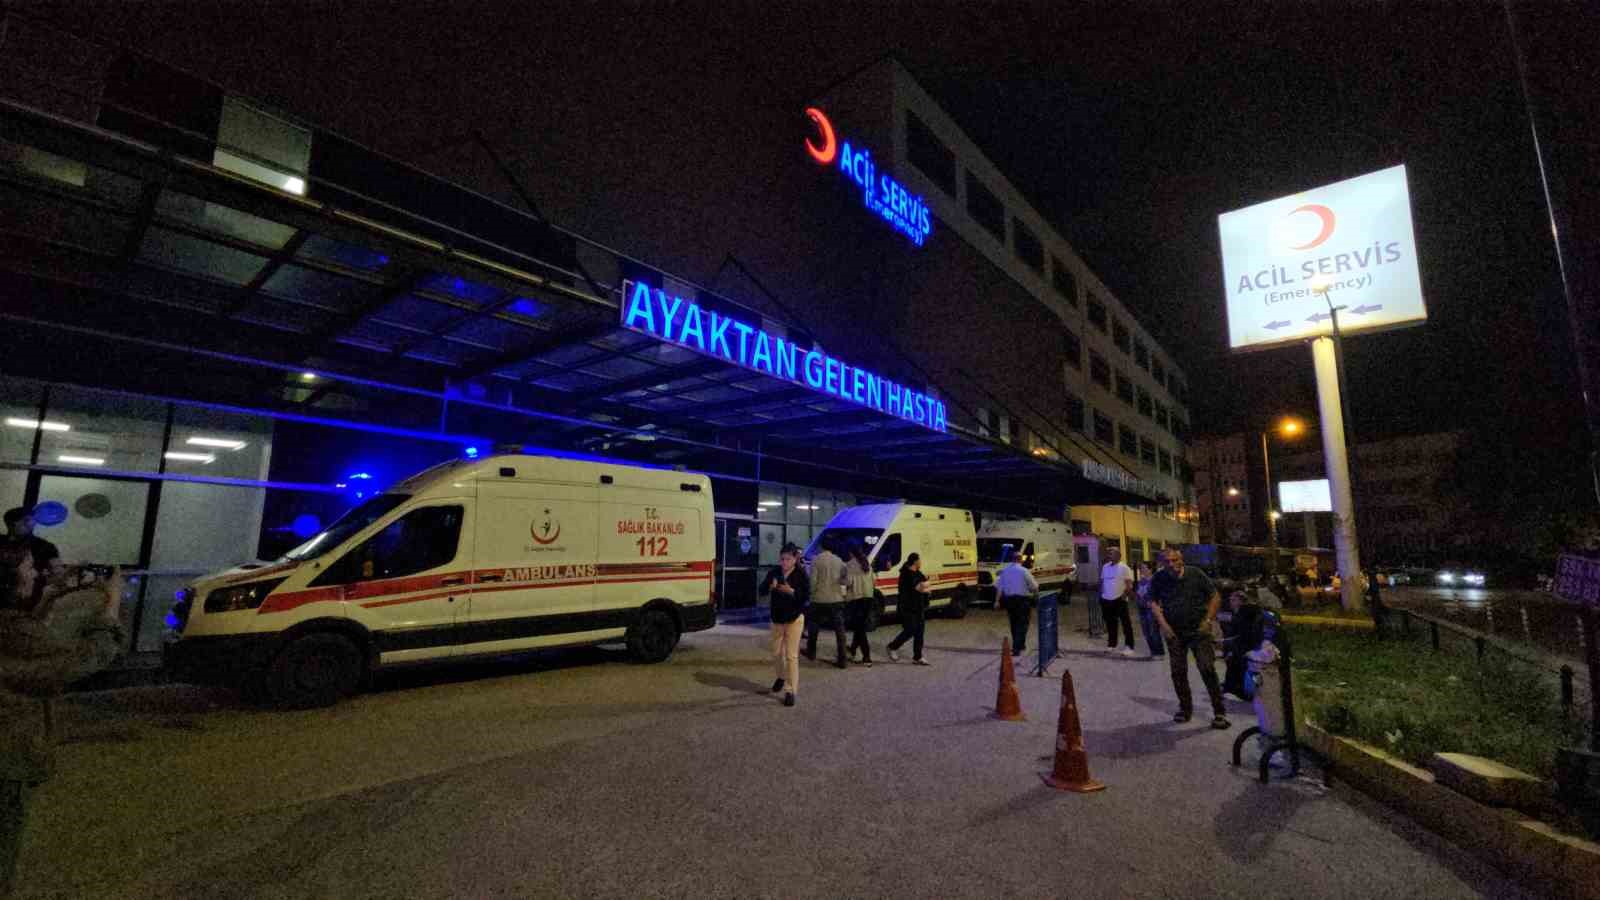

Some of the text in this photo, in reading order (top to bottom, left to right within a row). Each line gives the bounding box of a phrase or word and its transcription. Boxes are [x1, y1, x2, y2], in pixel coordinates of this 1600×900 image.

[841, 142, 930, 235] ACİL SERVİS
[1237, 241, 1402, 294] ACİL SERVİS
[625, 281, 947, 434] AYAKTAN GELEN HASTA
[502, 563, 597, 583] AMBULANS
[636, 536, 668, 557] 112
